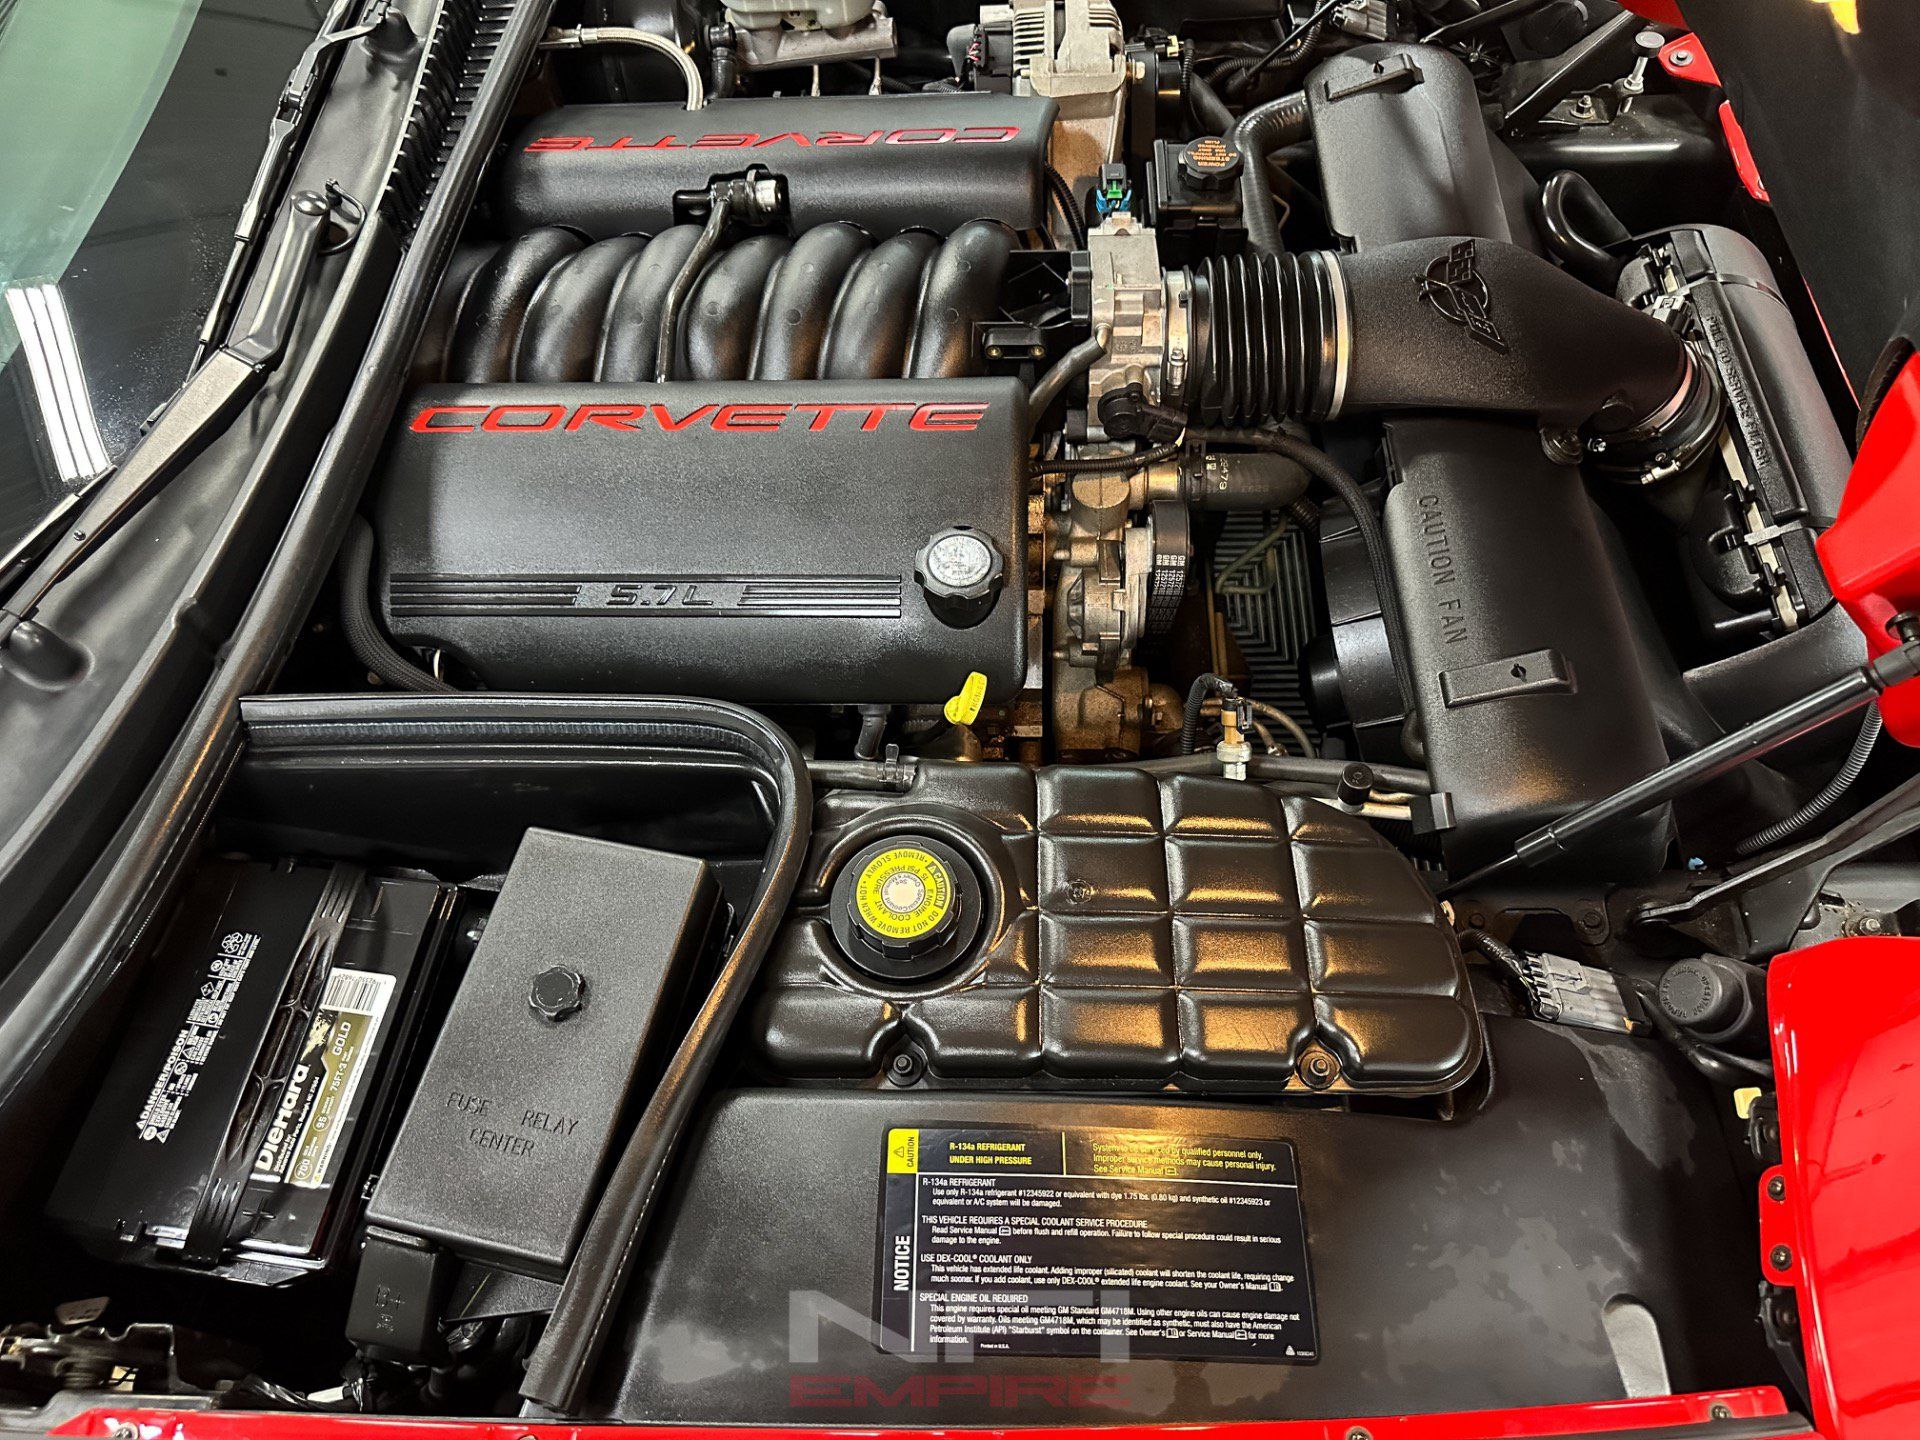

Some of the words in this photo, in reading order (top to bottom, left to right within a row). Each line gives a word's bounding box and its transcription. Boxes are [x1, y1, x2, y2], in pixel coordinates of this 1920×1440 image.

[524, 126, 1021, 153] CORVETTE
[408, 402, 990, 433] CORVETTE
[1417, 494, 1456, 586] CAUTION
[1438, 599, 1468, 644] FAN
[606, 584, 714, 606] 5.7L
[894, 850, 925, 861] REMOVE
[866, 855, 891, 878] SLOWLY
[873, 865, 906, 894] PRESSURE
[934, 873, 946, 907] CAUTION
[875, 900, 911, 921] COOLANT
[915, 889, 933, 917] ENGINE
[863, 902, 877, 923] WHEN
[928, 910, 939, 921] DO
[877, 921, 910, 934] REMOVE
[913, 921, 928, 932] NOT
[330, 1021, 352, 1056] GOLD
[446, 1091, 493, 1117] FUSE
[521, 1109, 579, 1136] RELAY
[315, 1115, 327, 1129] 95
[469, 1127, 535, 1158] CENTER
[950, 1143, 975, 1151] R-134a
[977, 1143, 1026, 1152] REFRIGERANT
[295, 1157, 310, 1177] 700
[950, 1155, 974, 1163] UNDER
[976, 1156, 993, 1164] HIGH
[994, 1156, 1032, 1165] PRESSURE
[1110, 1165, 1135, 1174] Service
[1138, 1167, 1163, 1175] Manual
[923, 1178, 948, 1186] R-134a
[949, 1179, 996, 1187] REFRIGERANT
[932, 1198, 964, 1206] equivalent
[973, 1198, 985, 1206] A/C
[986, 1199, 1009, 1207] system
[1031, 1200, 1062, 1208] damaged.
[985, 1189, 1017, 1198] refrigerant
[1064, 1191, 1095, 1199] equivalent
[1192, 1195, 1219, 1204] synthetic
[922, 1215, 937, 1223] THIS
[939, 1216, 967, 1224] VEHICLE
[969, 1216, 1003, 1225] REQUIRES
[1004, 1217, 1010, 1225] A
[1011, 1217, 1040, 1225] SPECIAL
[1042, 1218, 1074, 1226] COOLANT
[1076, 1218, 1104, 1226] SERVICE
[1106, 1219, 1148, 1228] PROCEDURE
[931, 1236, 957, 1244] damage
[949, 1226, 972, 1234] Service
[1051, 1228, 1063, 1236] and
[1065, 1228, 1078, 1236] refill
[1080, 1229, 1110, 1237] operation.
[1112, 1230, 1133, 1238] Failure
[1234, 1234, 1251, 1242] result
[893, 1235, 911, 1291] NOTICE
[920, 1254, 935, 1262] USE
[979, 1254, 1012, 1262] COOLANT
[1014, 1255, 1032, 1263] ONLY
[1008, 1276, 1032, 1284] coolant,
[1047, 1277, 1060, 1285] only
[1100, 1278, 1130, 1286] extended
[1191, 1280, 1202, 1288] See
[1246, 1282, 1268, 1290] Manual
[920, 1293, 949, 1301] SPECIAL
[951, 1293, 977, 1302] ENGINE
[979, 1294, 991, 1302] OIL
[993, 1294, 1028, 1302] REQUIRED
